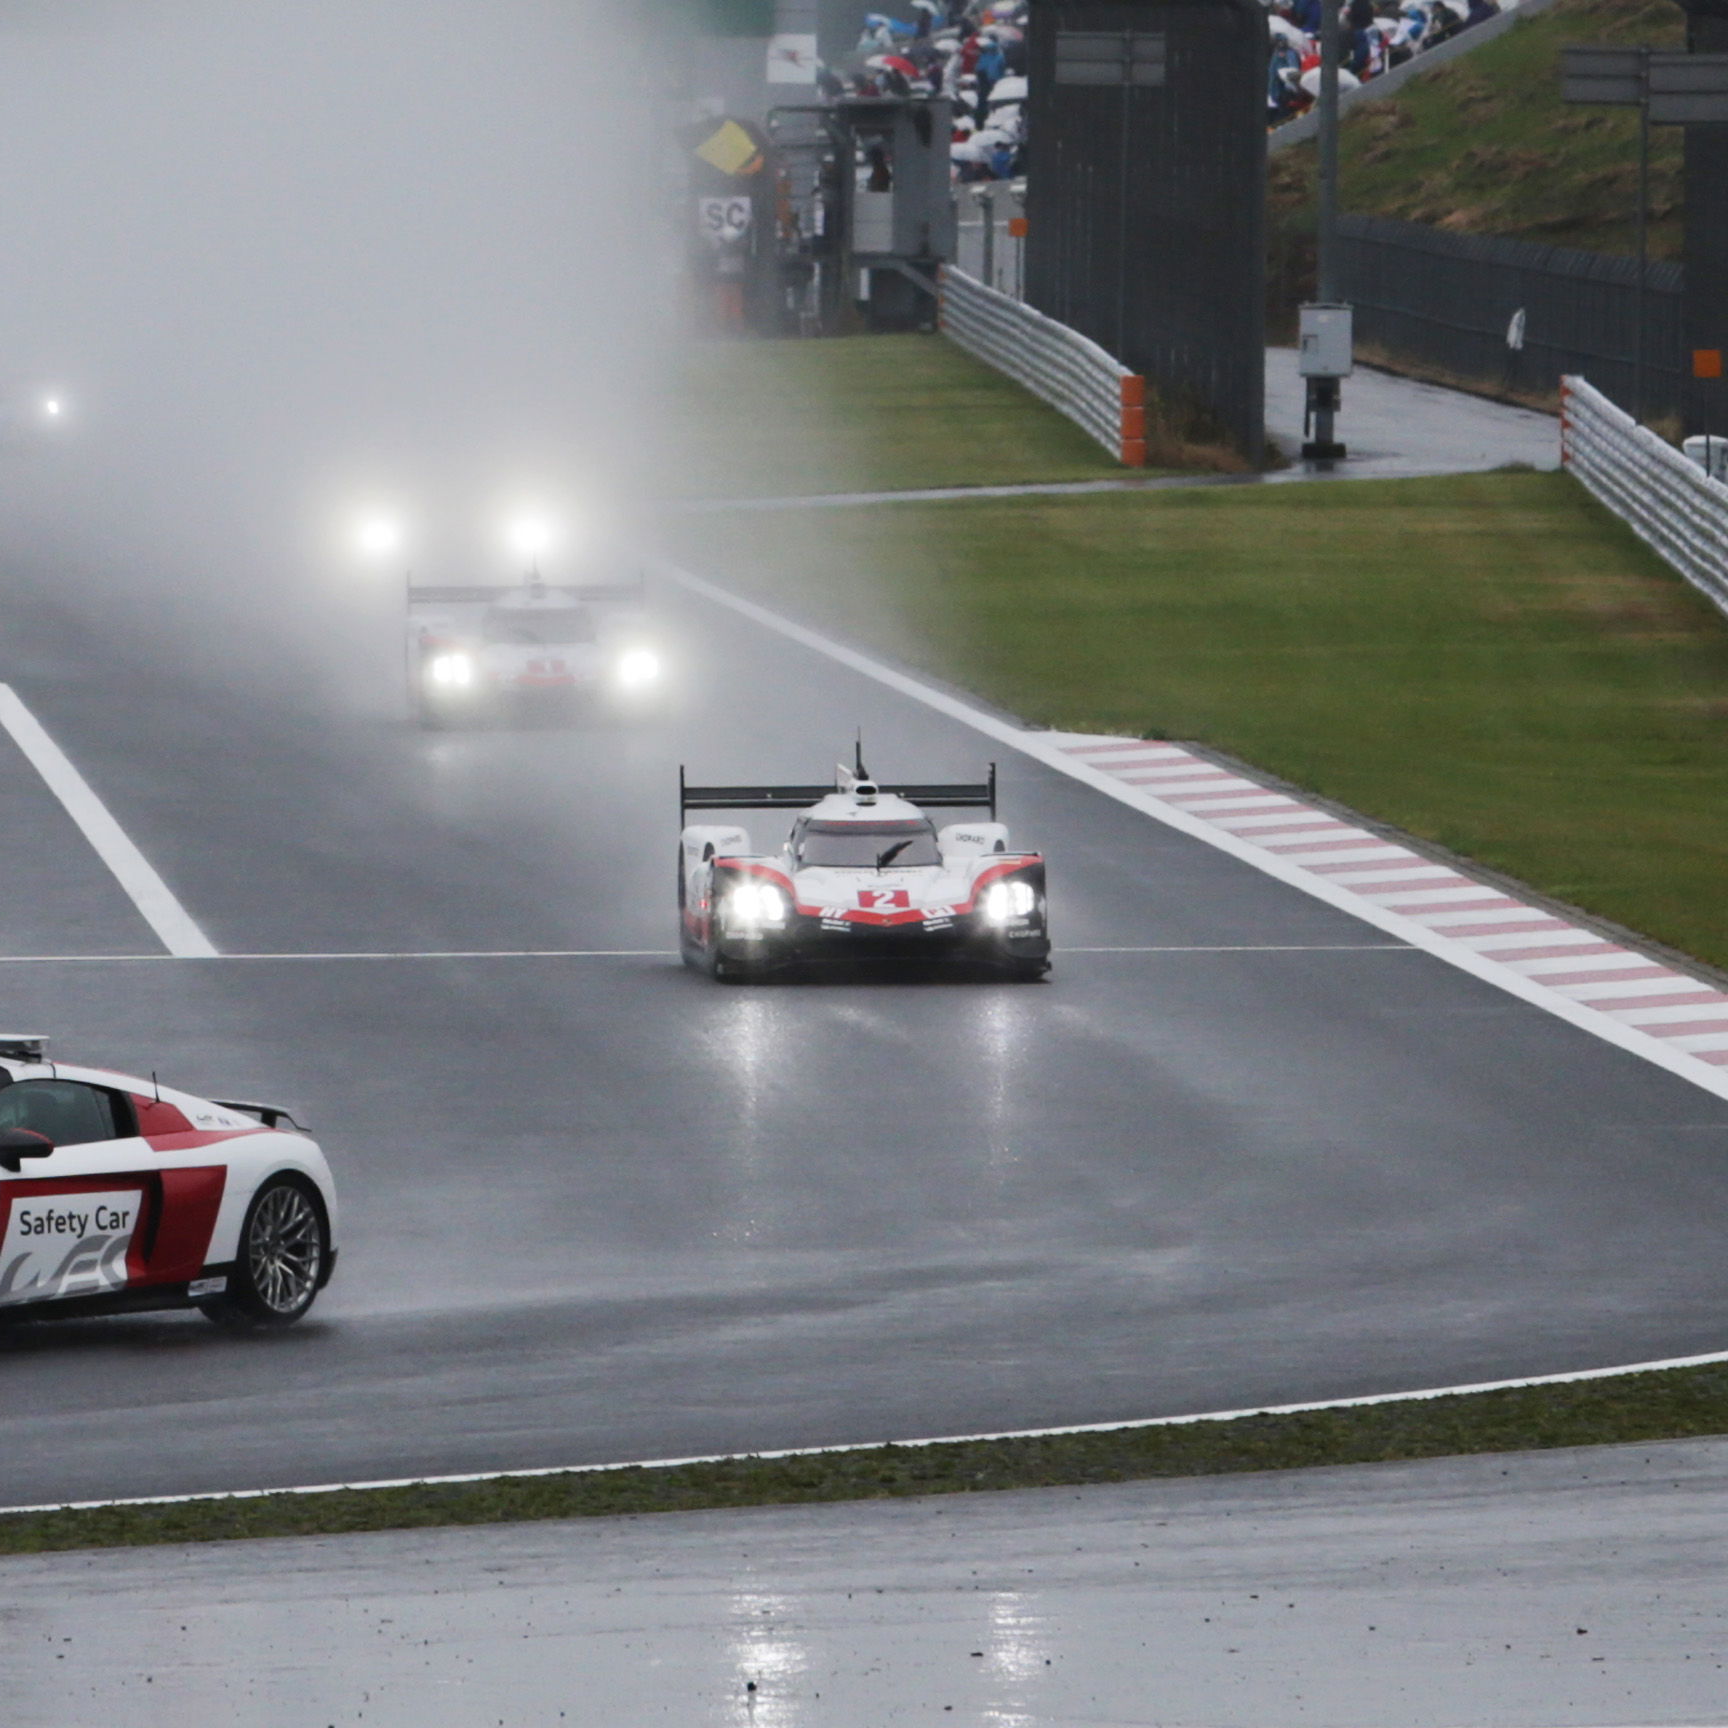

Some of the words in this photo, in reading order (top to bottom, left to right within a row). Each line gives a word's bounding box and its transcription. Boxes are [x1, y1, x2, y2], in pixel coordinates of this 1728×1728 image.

[874, 891, 896, 908] 2
[19, 1208, 89, 1239] Safety
[95, 1205, 130, 1231] Car
